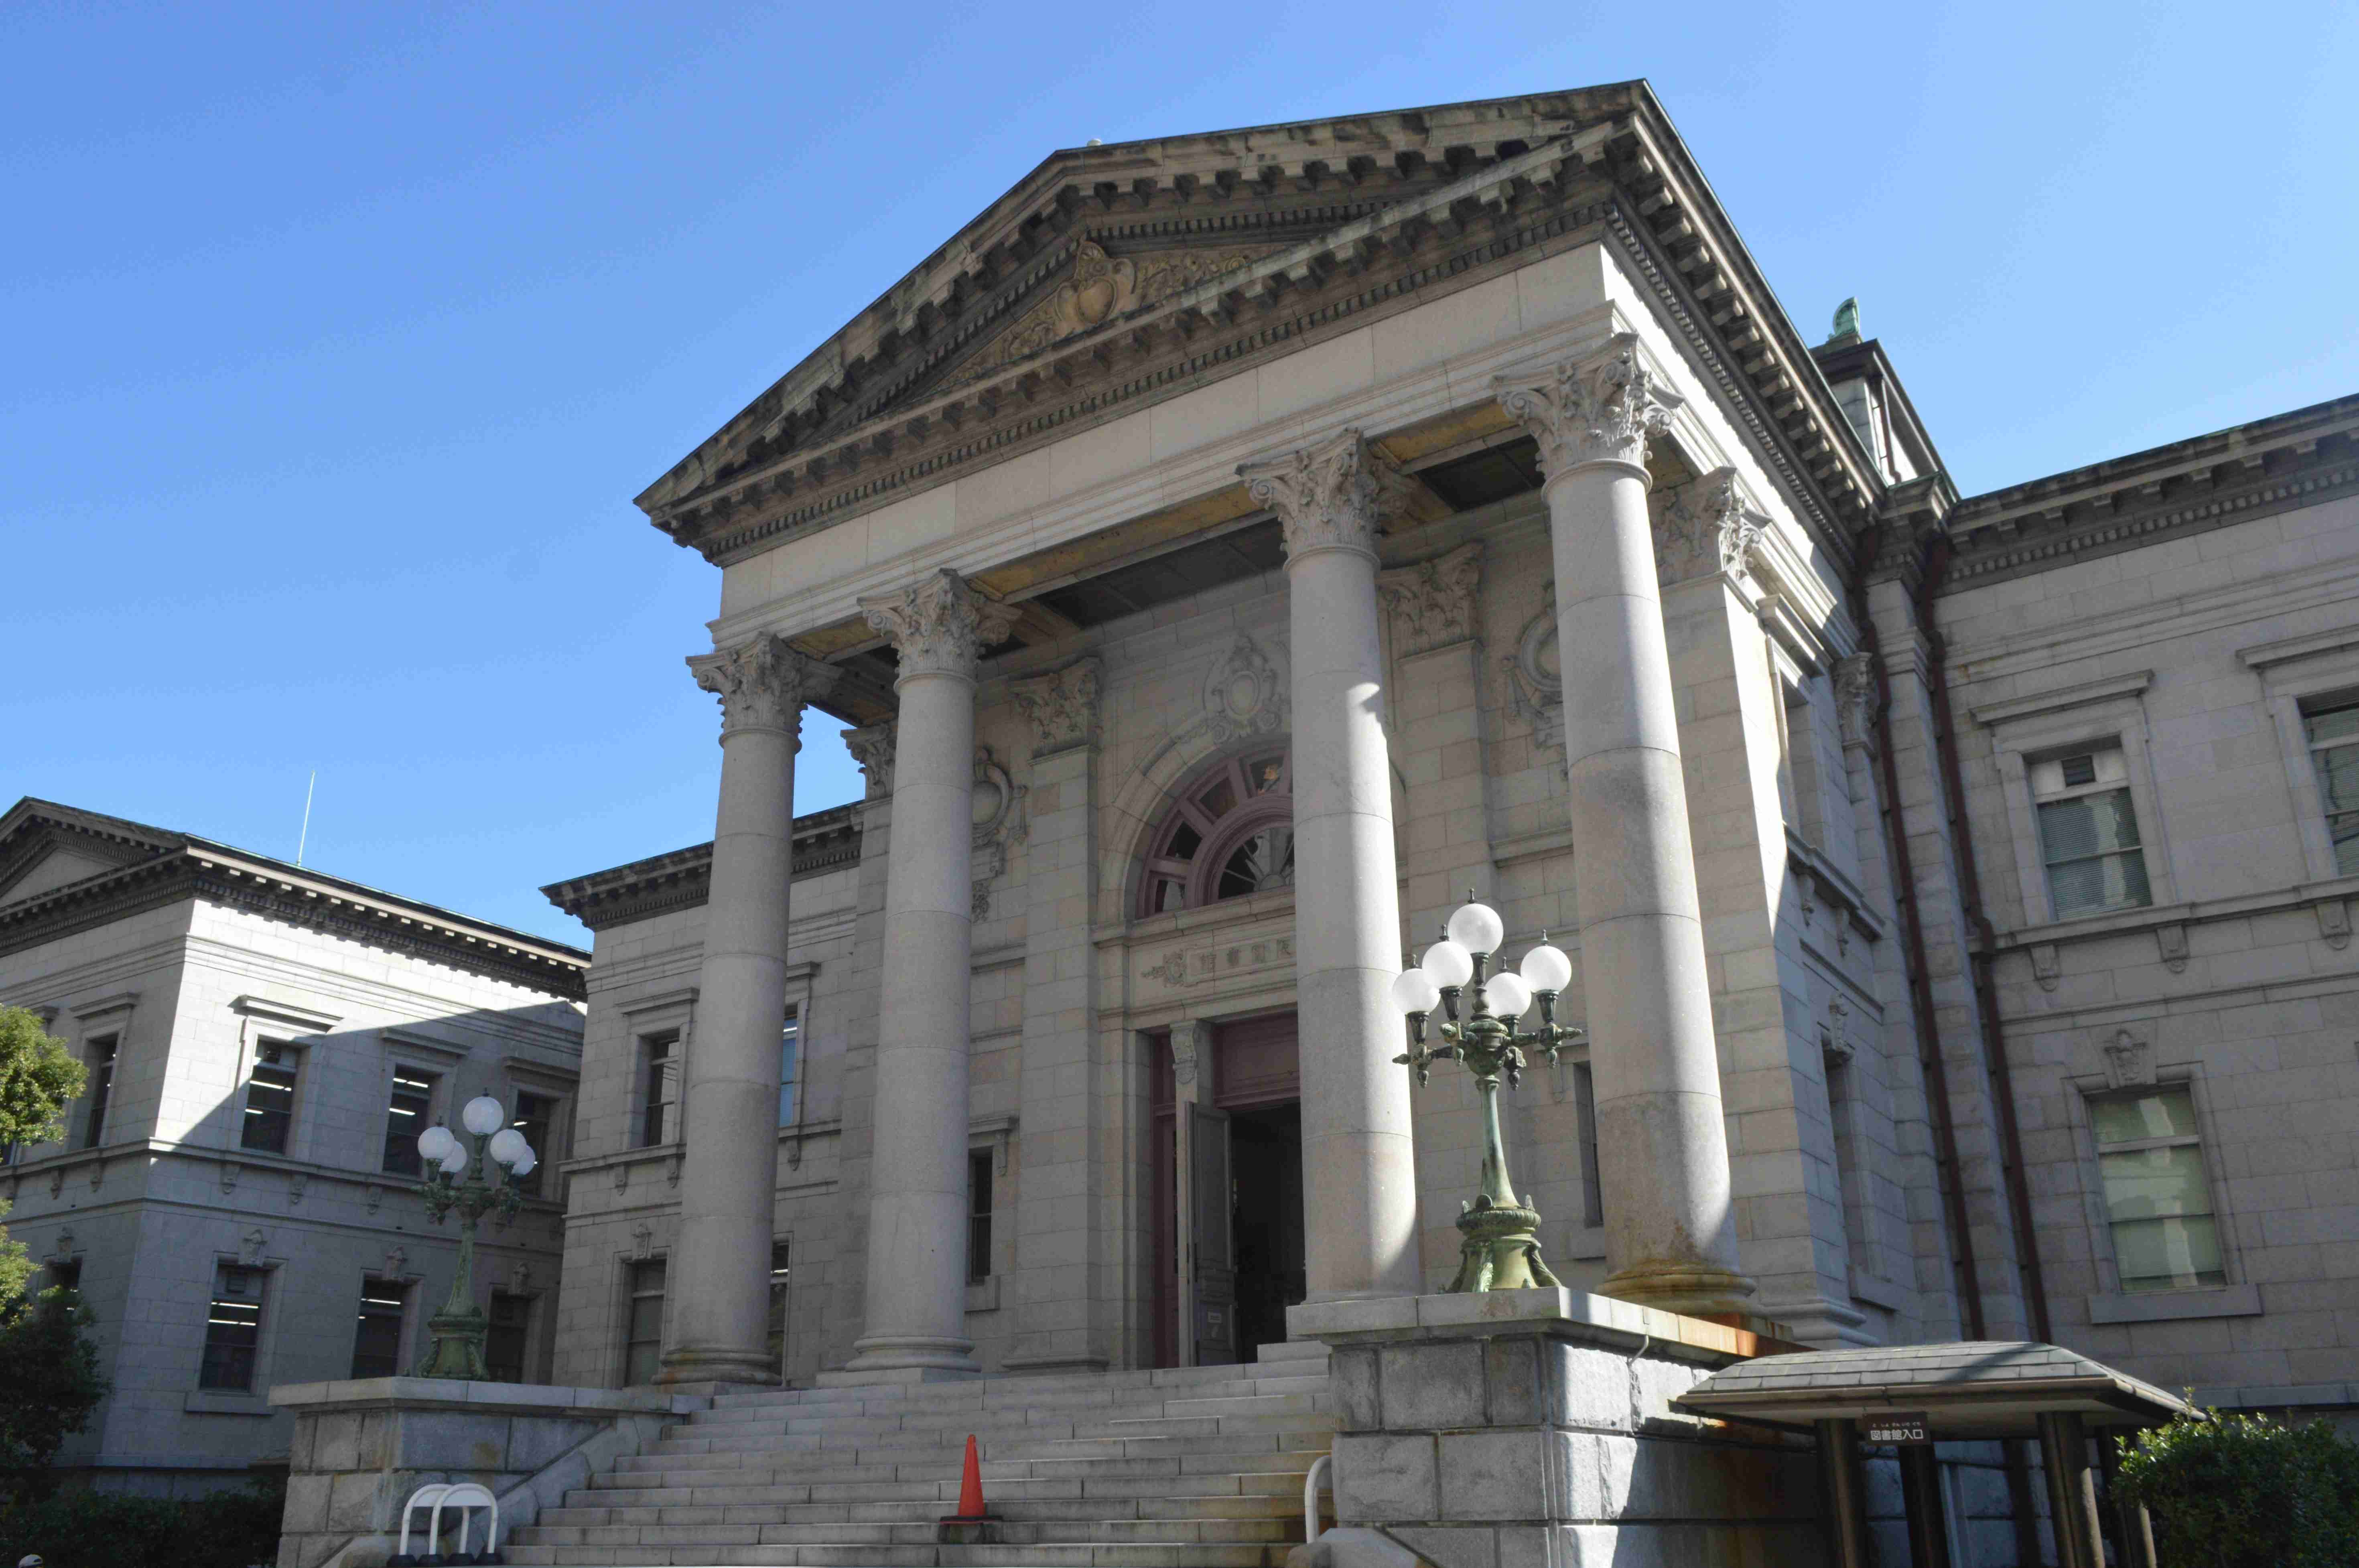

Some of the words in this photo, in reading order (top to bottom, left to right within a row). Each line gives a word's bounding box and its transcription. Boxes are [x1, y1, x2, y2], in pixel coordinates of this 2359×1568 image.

[1870, 1429, 1923, 1440] 図書館入口
